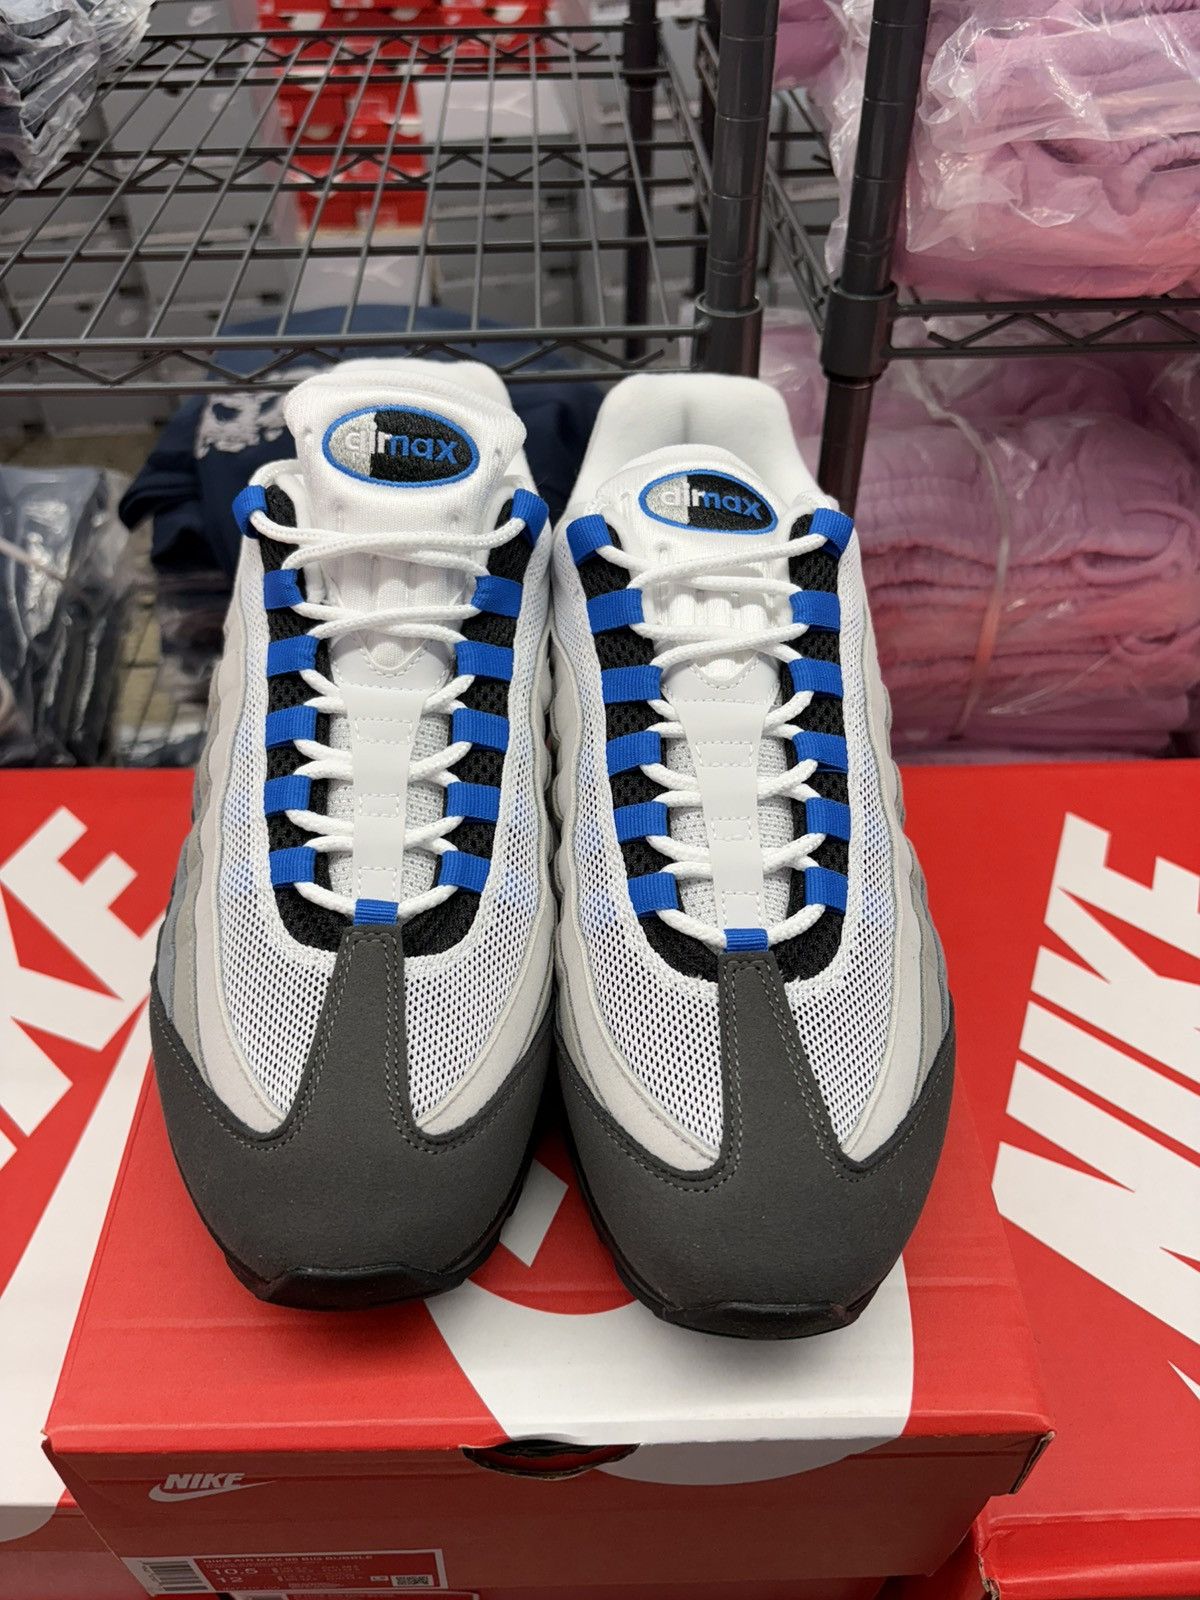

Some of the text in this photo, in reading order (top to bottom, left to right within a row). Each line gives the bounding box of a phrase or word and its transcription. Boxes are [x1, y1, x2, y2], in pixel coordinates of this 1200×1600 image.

[345, 420, 459, 465] airmax
[660, 482, 763, 520] airmax
[162, 1472, 246, 1490] NIKE
[209, 1567, 259, 1575] 10.5
